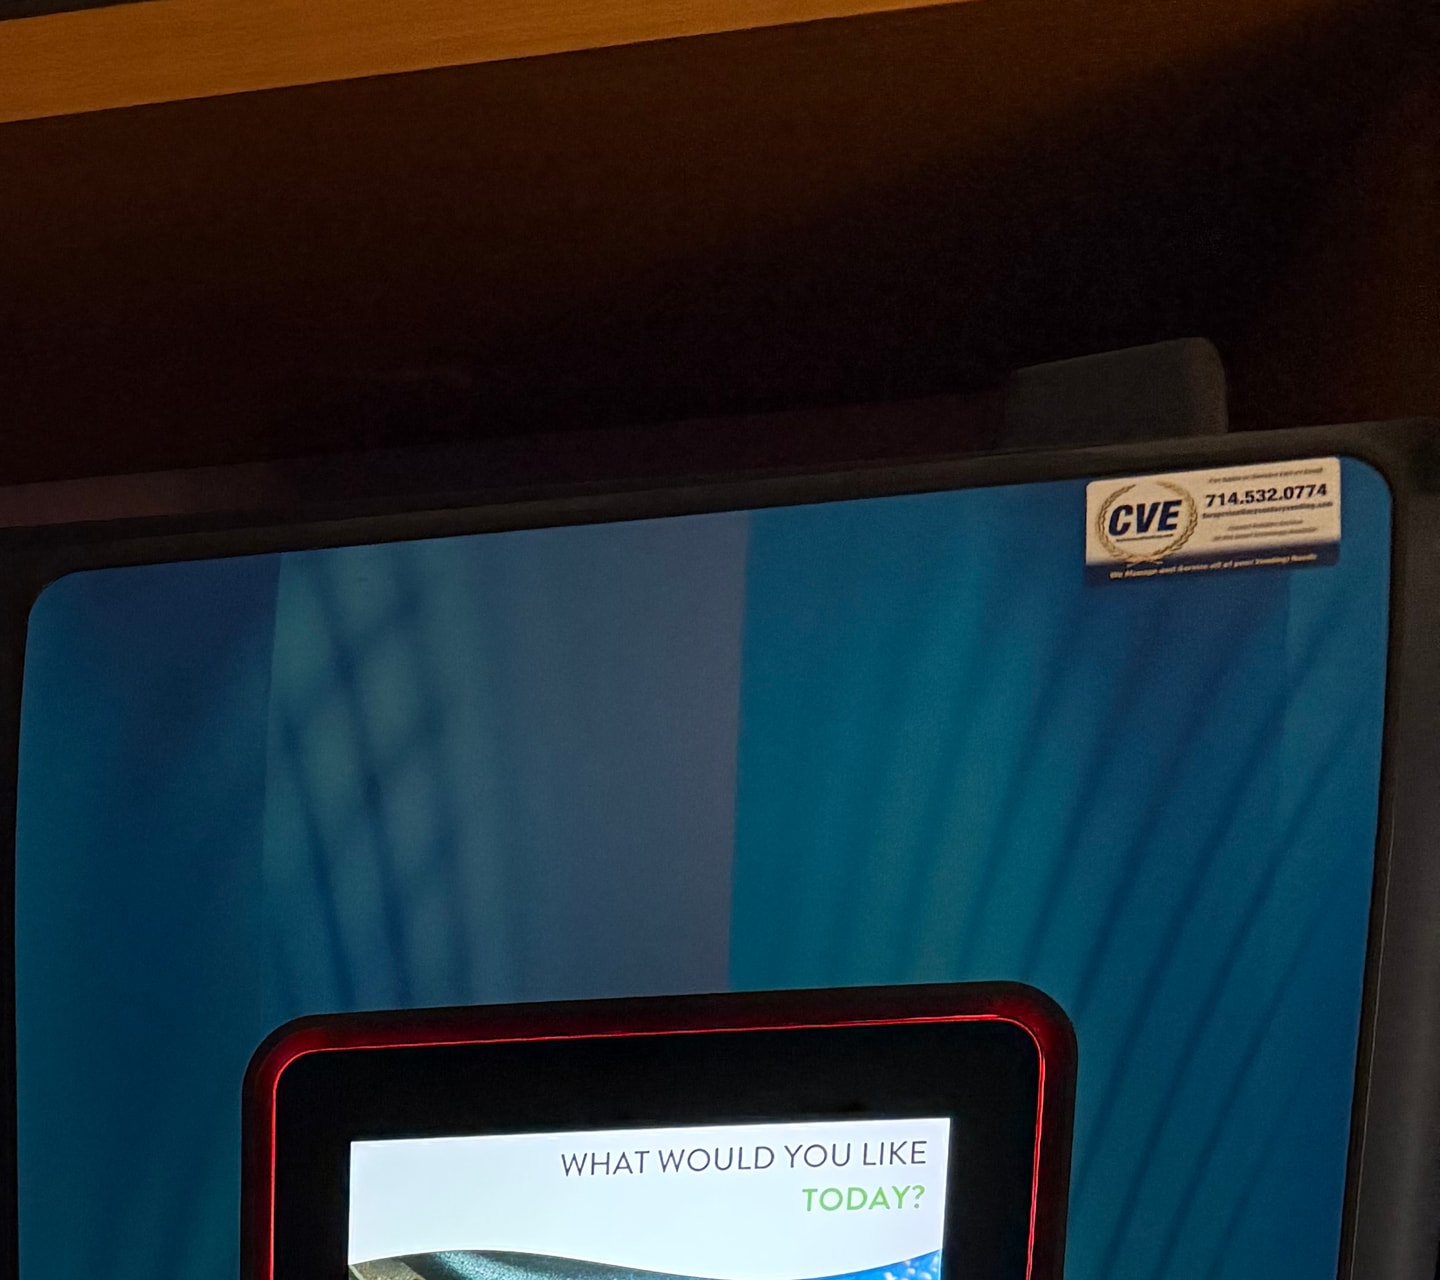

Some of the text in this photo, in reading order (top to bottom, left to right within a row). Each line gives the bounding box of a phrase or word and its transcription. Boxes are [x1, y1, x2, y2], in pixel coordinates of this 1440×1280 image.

[1205, 483, 1327, 508] 714.532.0774
[1108, 499, 1182, 537] CVE
[561, 1140, 927, 1177] WHAT WOULD YOU LIKE
[802, 1185, 926, 1212] TODAY?
